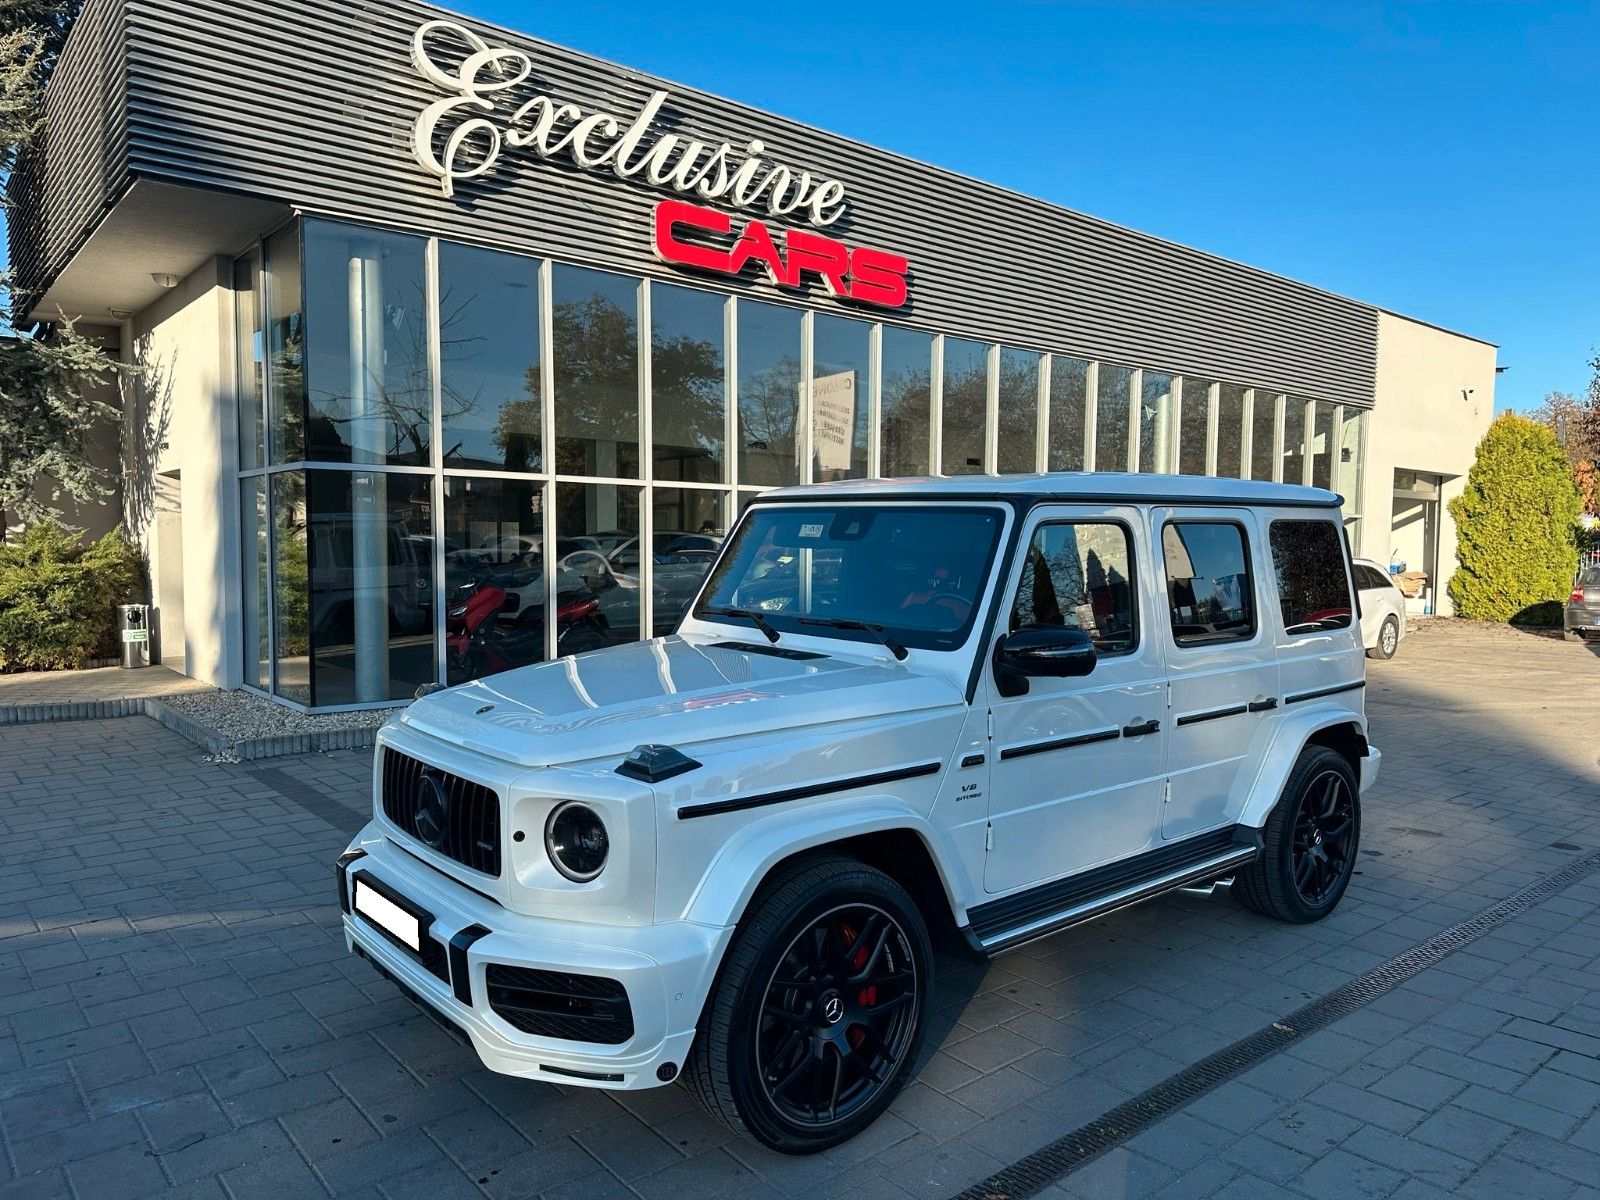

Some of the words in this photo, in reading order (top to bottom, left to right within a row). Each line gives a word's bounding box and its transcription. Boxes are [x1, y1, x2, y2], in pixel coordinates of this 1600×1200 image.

[410, 20, 847, 226] Exclusive
[651, 200, 909, 307] CARS
[962, 783, 977, 792] V8
